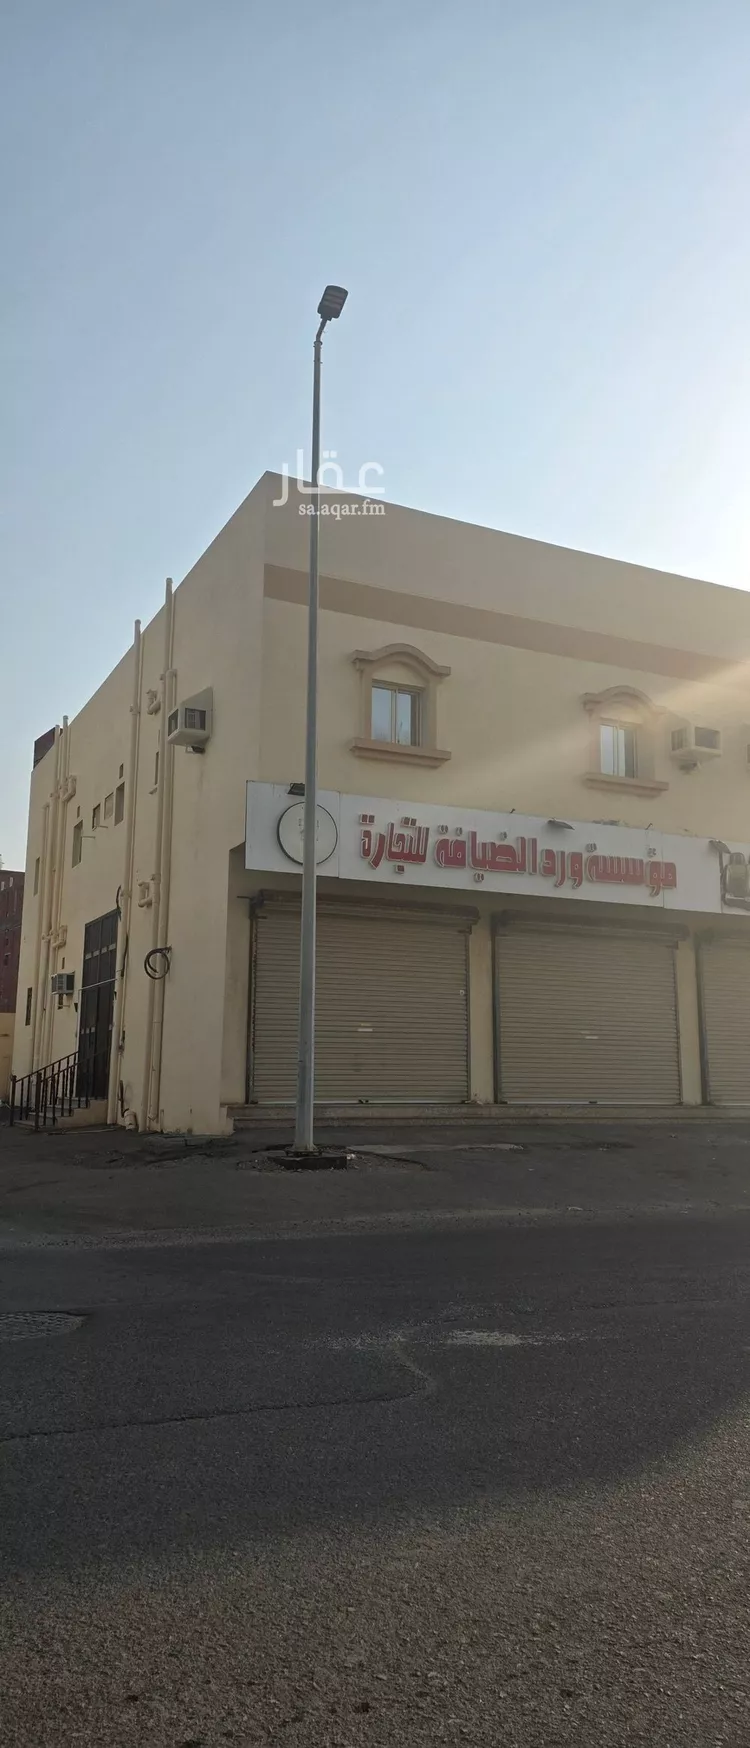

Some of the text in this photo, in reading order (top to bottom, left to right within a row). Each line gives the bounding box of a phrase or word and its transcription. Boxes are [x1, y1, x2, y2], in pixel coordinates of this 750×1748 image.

[359, 813, 430, 874] للتجارة
[434, 824, 538, 883] الضيافة
[540, 848, 583, 889] ورد
[585, 843, 677, 897] مؤسسة
